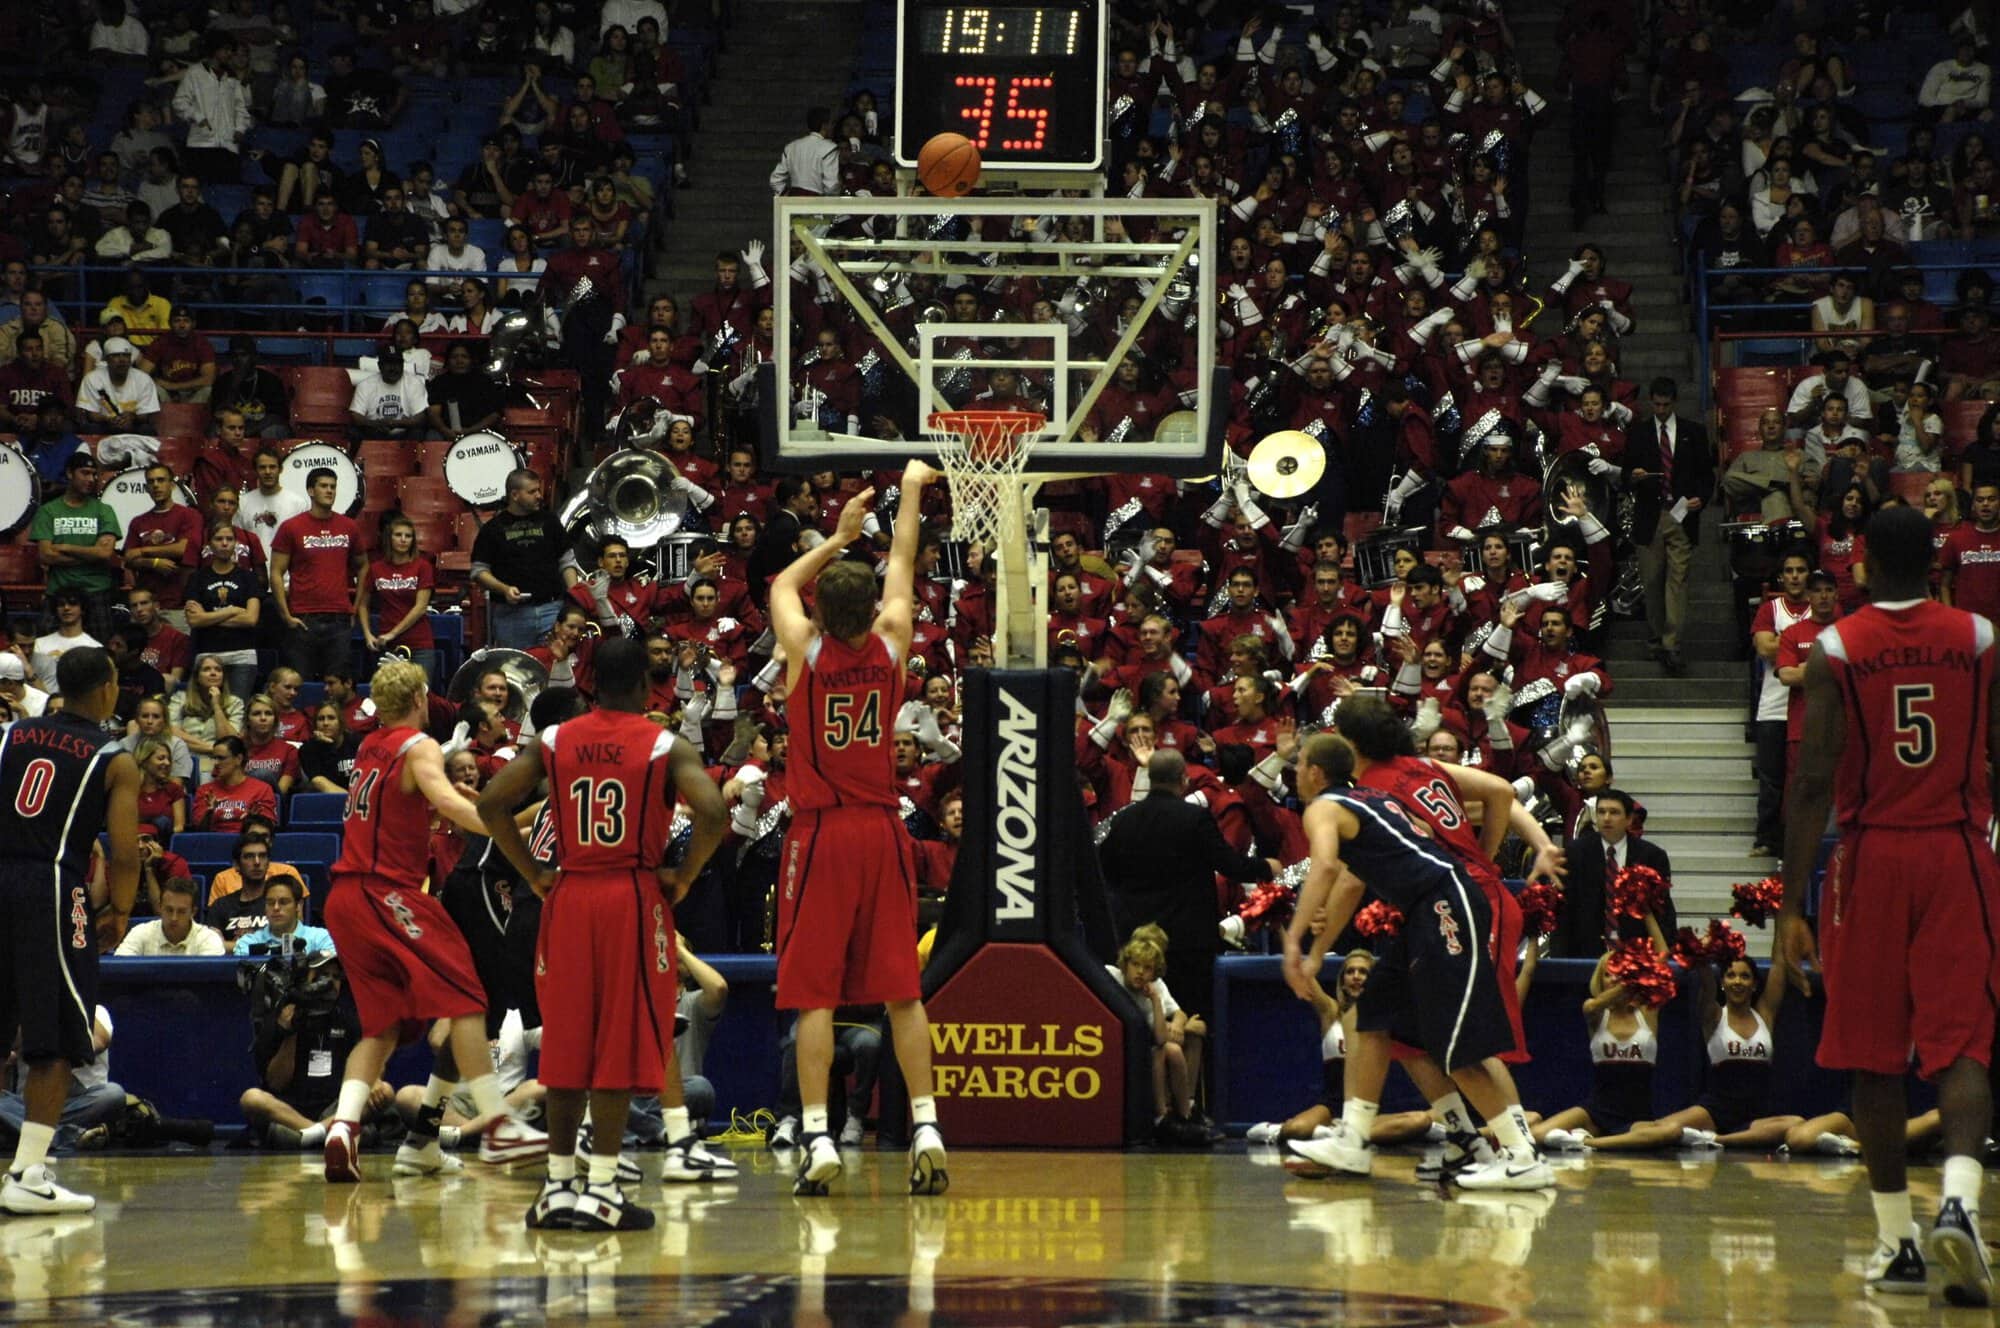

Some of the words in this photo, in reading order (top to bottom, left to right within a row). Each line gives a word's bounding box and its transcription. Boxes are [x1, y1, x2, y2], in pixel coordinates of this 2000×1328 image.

[942, 9, 1079, 55] 19:11
[954, 75, 1054, 150] 35
[9, 389, 53, 406] OBE
[303, 456, 338, 468] YAMAHA
[466, 443, 501, 458] YAMAHA
[130, 482, 147, 494] YAM
[54, 517, 98, 528] BOSTON
[819, 665, 889, 689] WALTERS
[824, 689, 883, 749] 54
[1893, 683, 1936, 768] 5
[12, 728, 95, 759] BAYLESS
[576, 743, 625, 764] WISE
[14, 757, 56, 818] 0
[995, 687, 1038, 922] ARIZONA
[570, 776, 627, 847] 13
[71, 887, 87, 949] CATS
[653, 903, 670, 973] CATS
[1433, 900, 1464, 956] CATS
[928, 1023, 1104, 1057] WELLS
[932, 1066, 1101, 1099] FARGO
